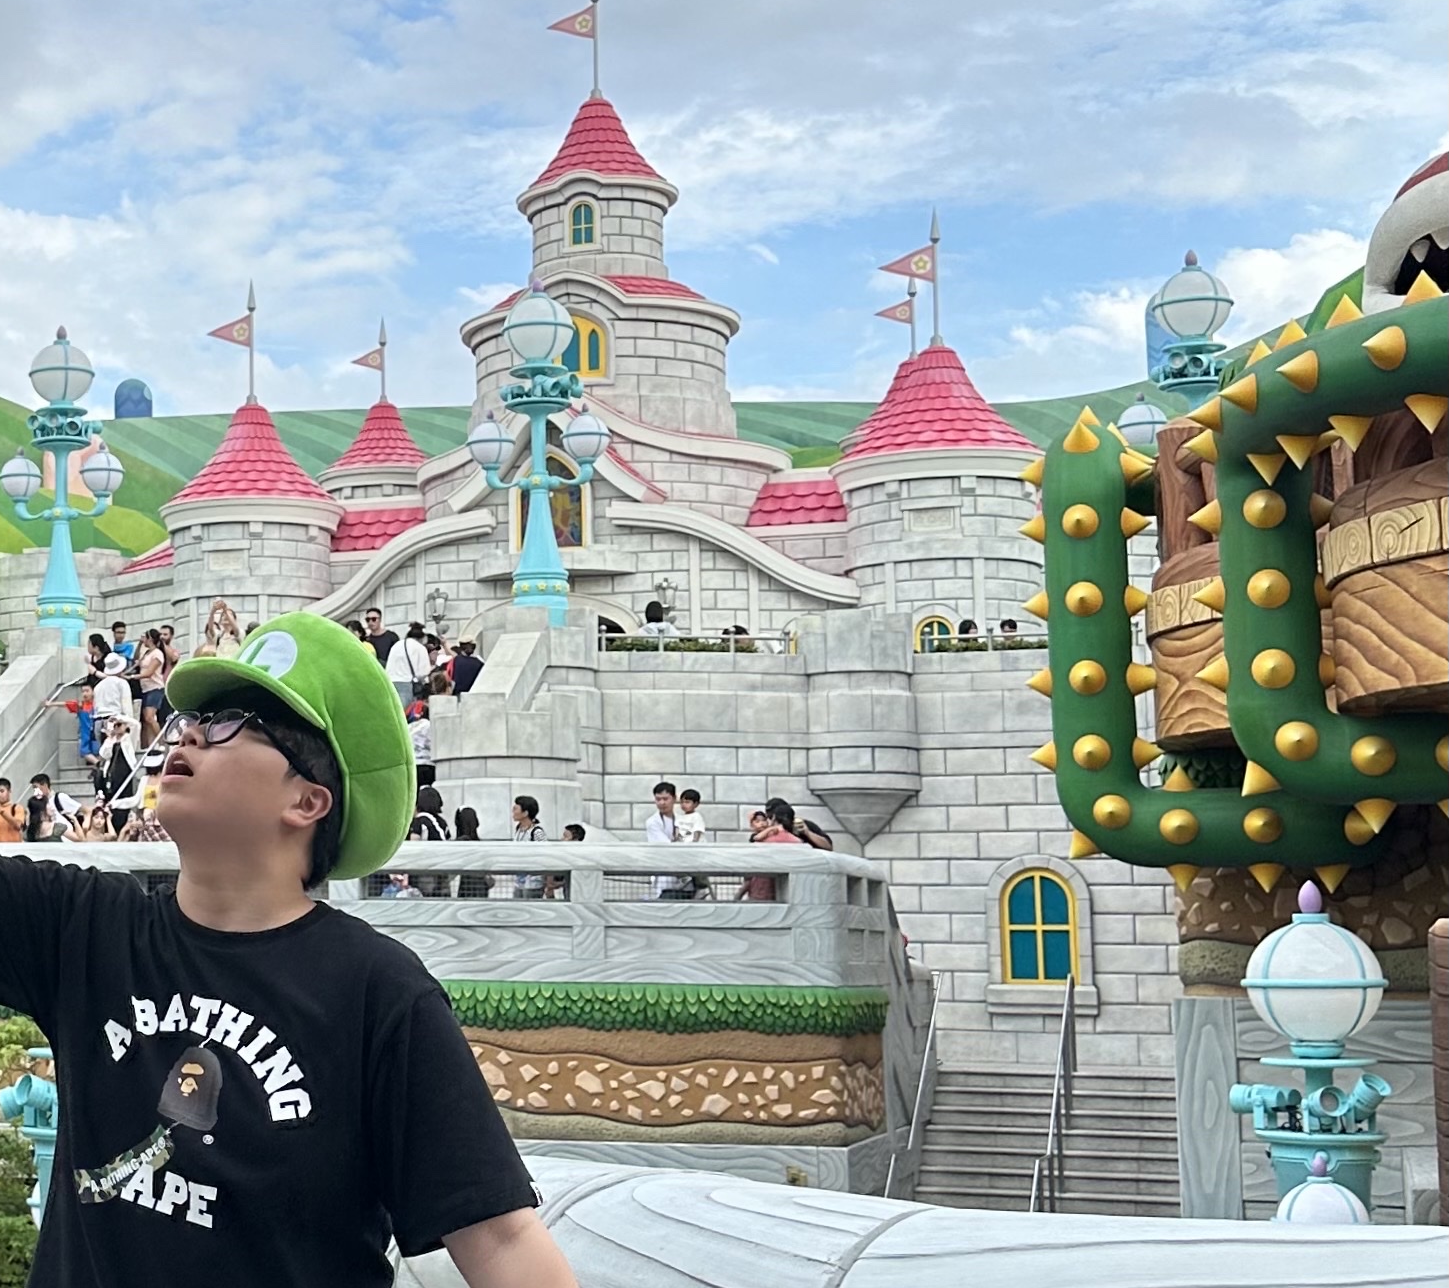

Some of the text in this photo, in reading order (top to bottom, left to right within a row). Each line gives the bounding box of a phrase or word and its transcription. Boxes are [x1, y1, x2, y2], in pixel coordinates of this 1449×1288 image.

[103, 993, 312, 1122] A BATHING
[120, 1164, 218, 1229] APE
